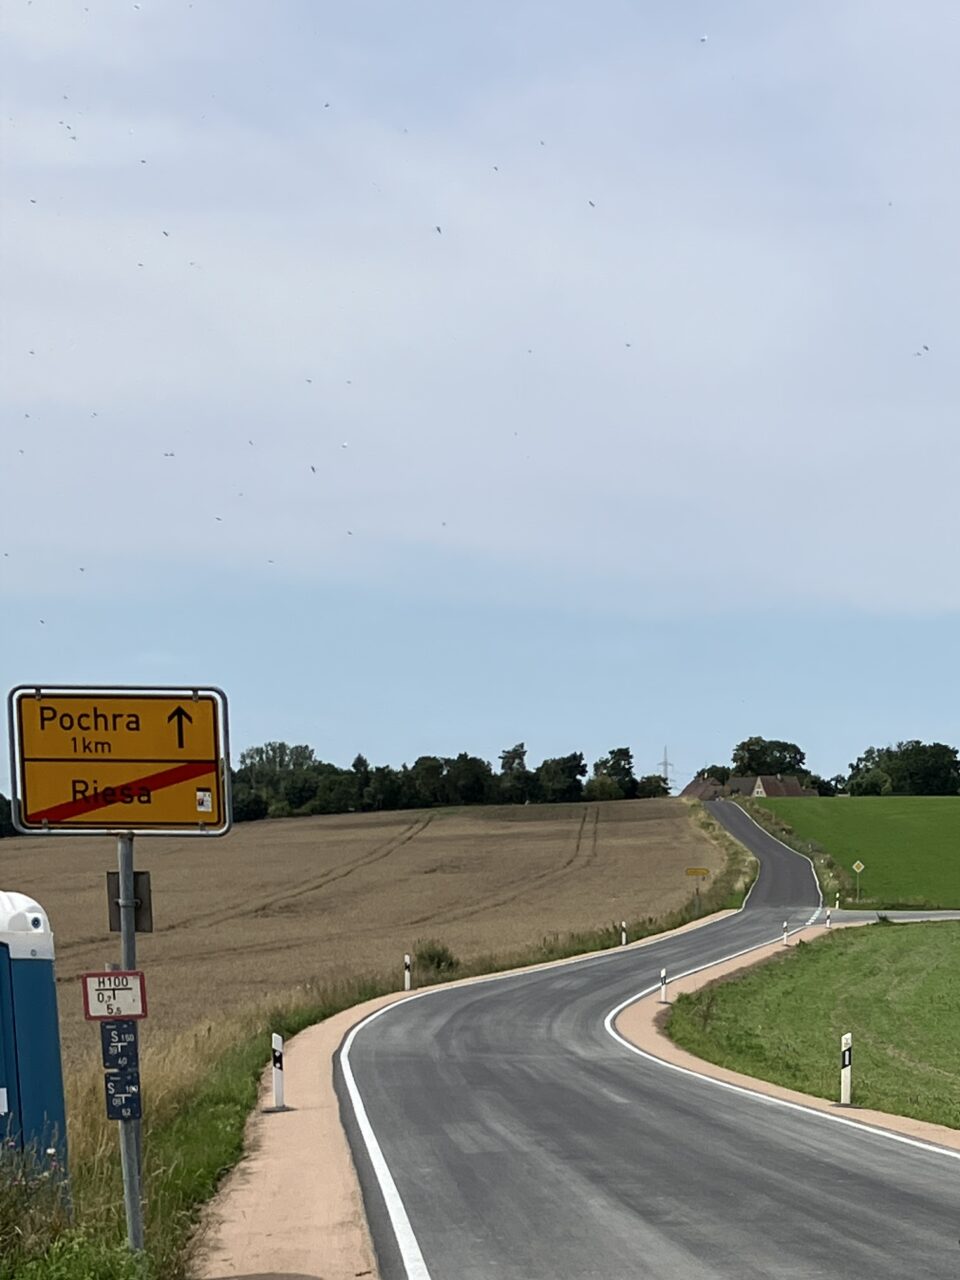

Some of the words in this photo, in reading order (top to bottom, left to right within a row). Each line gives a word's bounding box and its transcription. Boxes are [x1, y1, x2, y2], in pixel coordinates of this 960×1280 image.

[38, 705, 141, 731] Pochra
[71, 779, 152, 804] Riesa
[110, 1030, 119, 1042] S
[107, 1082, 115, 1094] S
